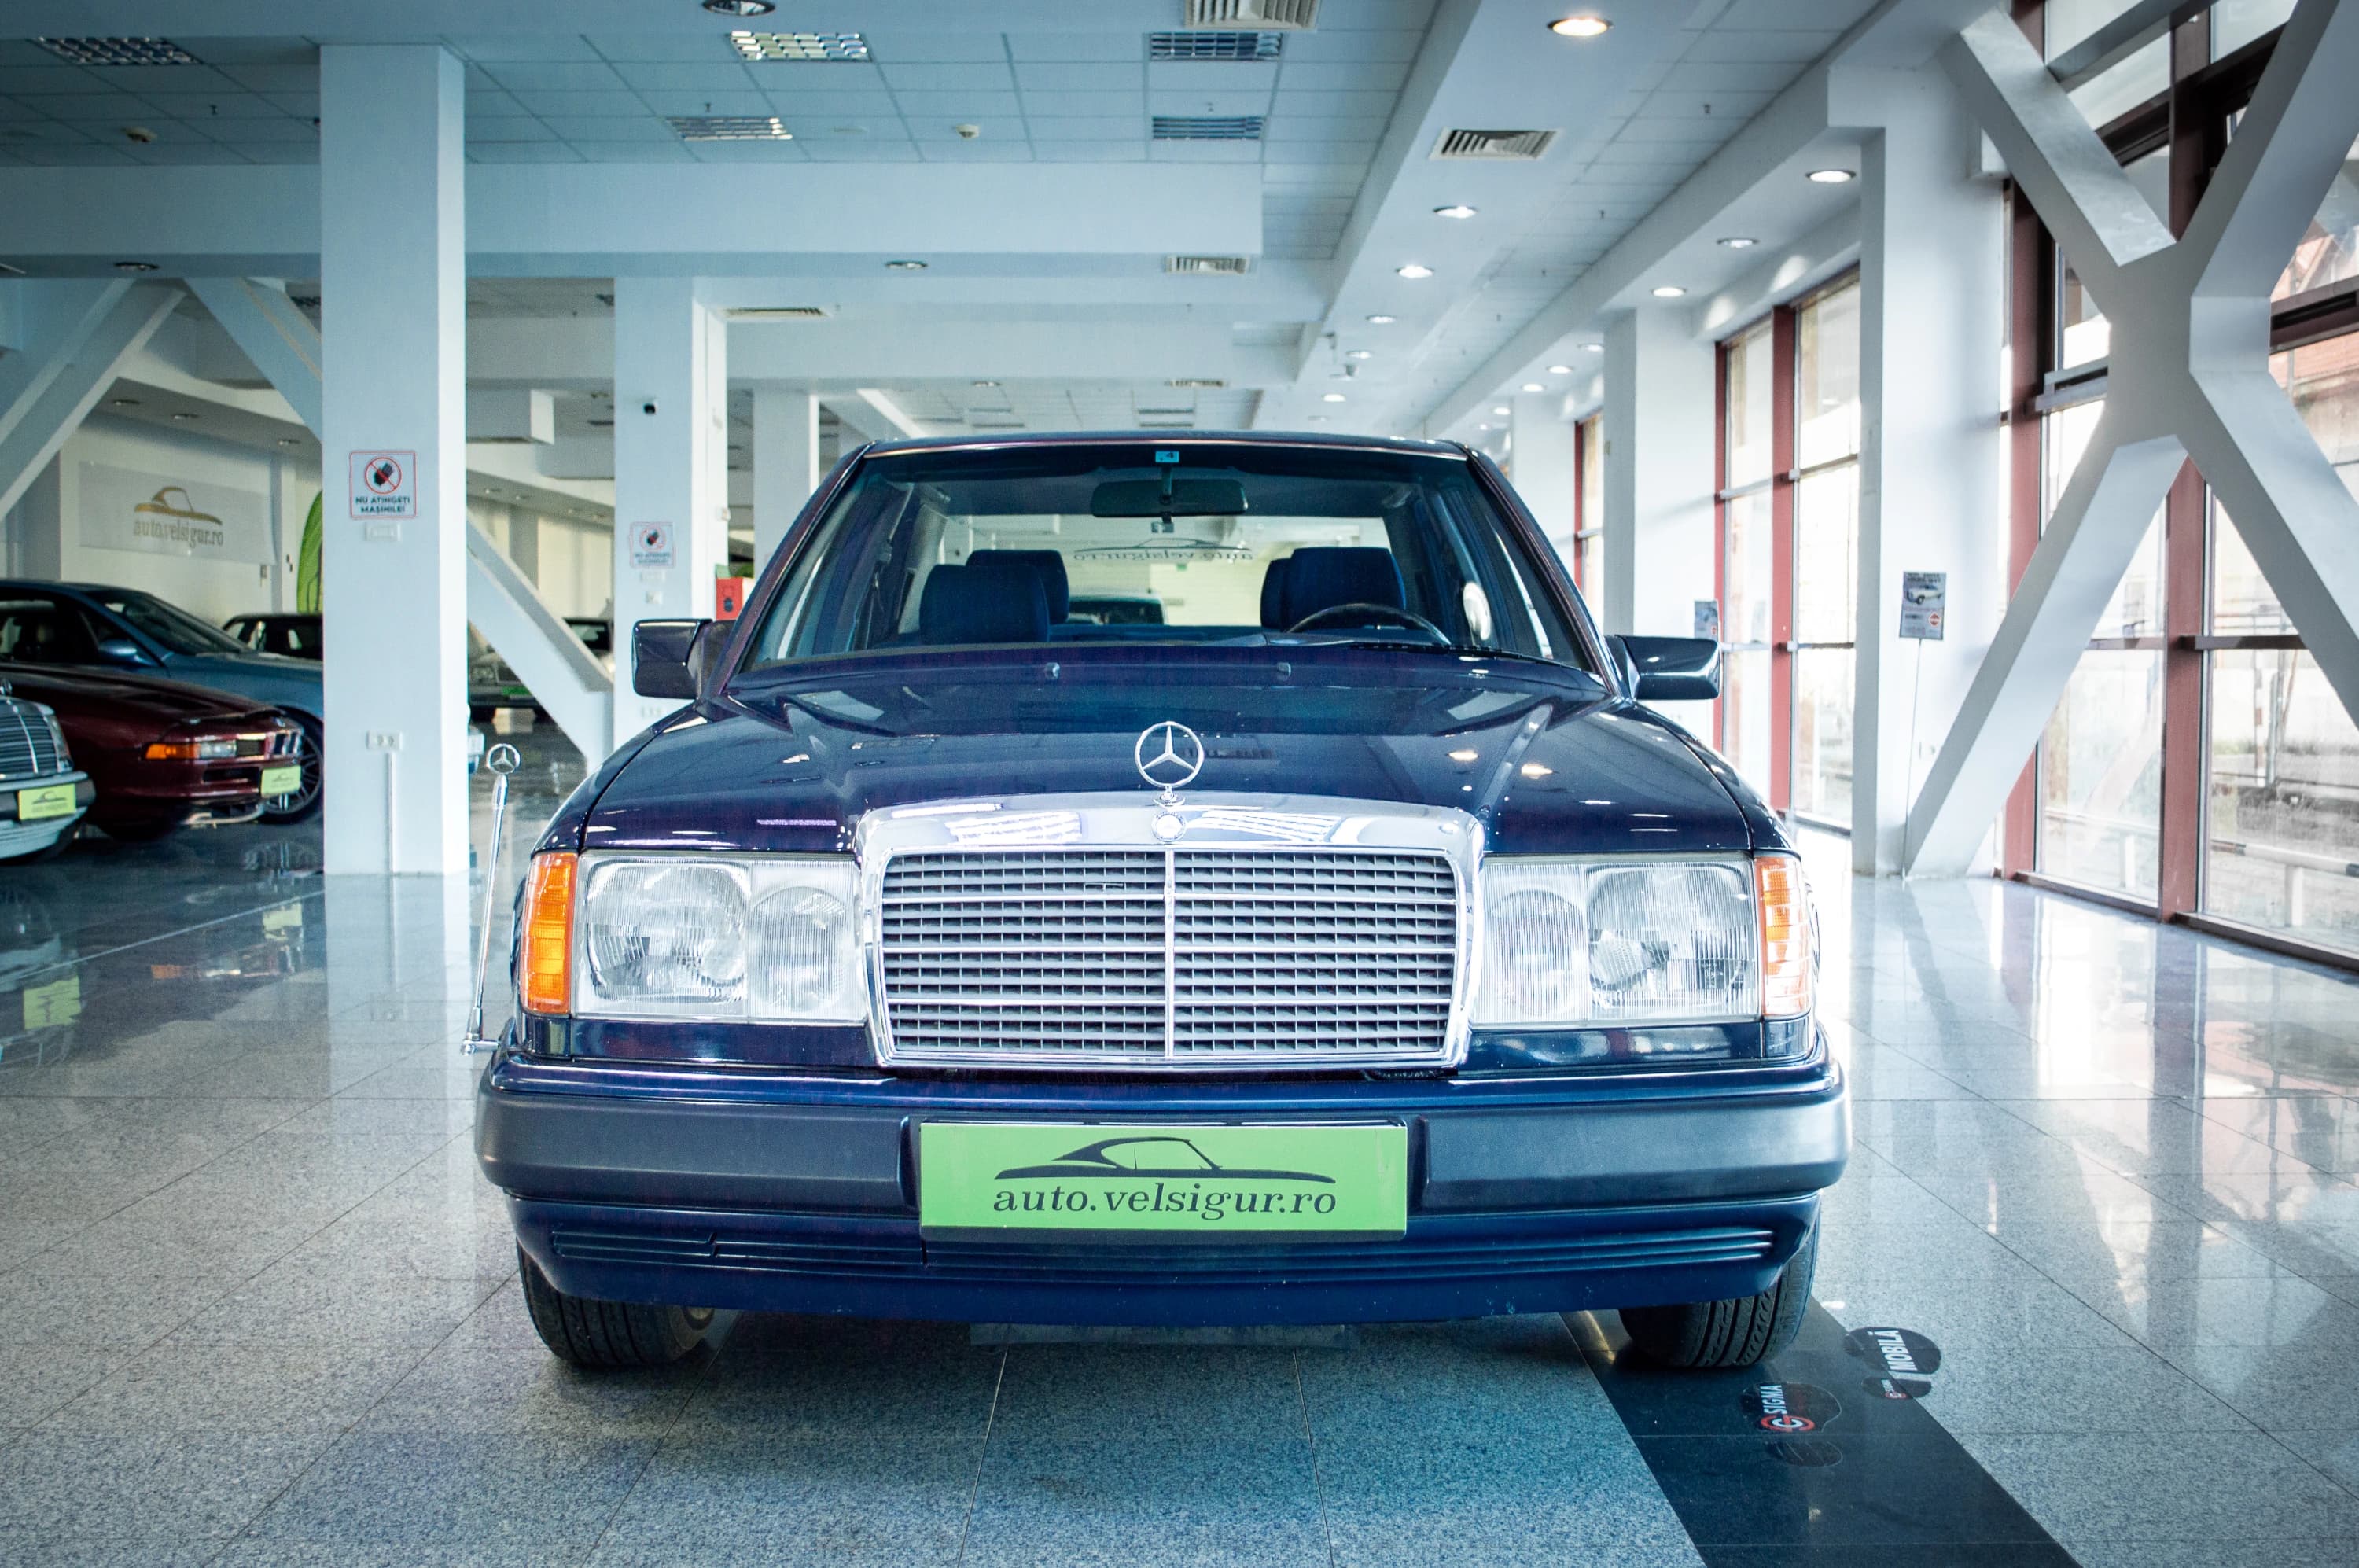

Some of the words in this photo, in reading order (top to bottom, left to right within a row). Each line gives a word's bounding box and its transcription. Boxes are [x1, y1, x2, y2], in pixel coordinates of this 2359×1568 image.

[994, 1183, 1336, 1220] auto.velsigur.ro
[1868, 1330, 1917, 1371] MOBILĂ
[1760, 1385, 1787, 1415] SIGMA
